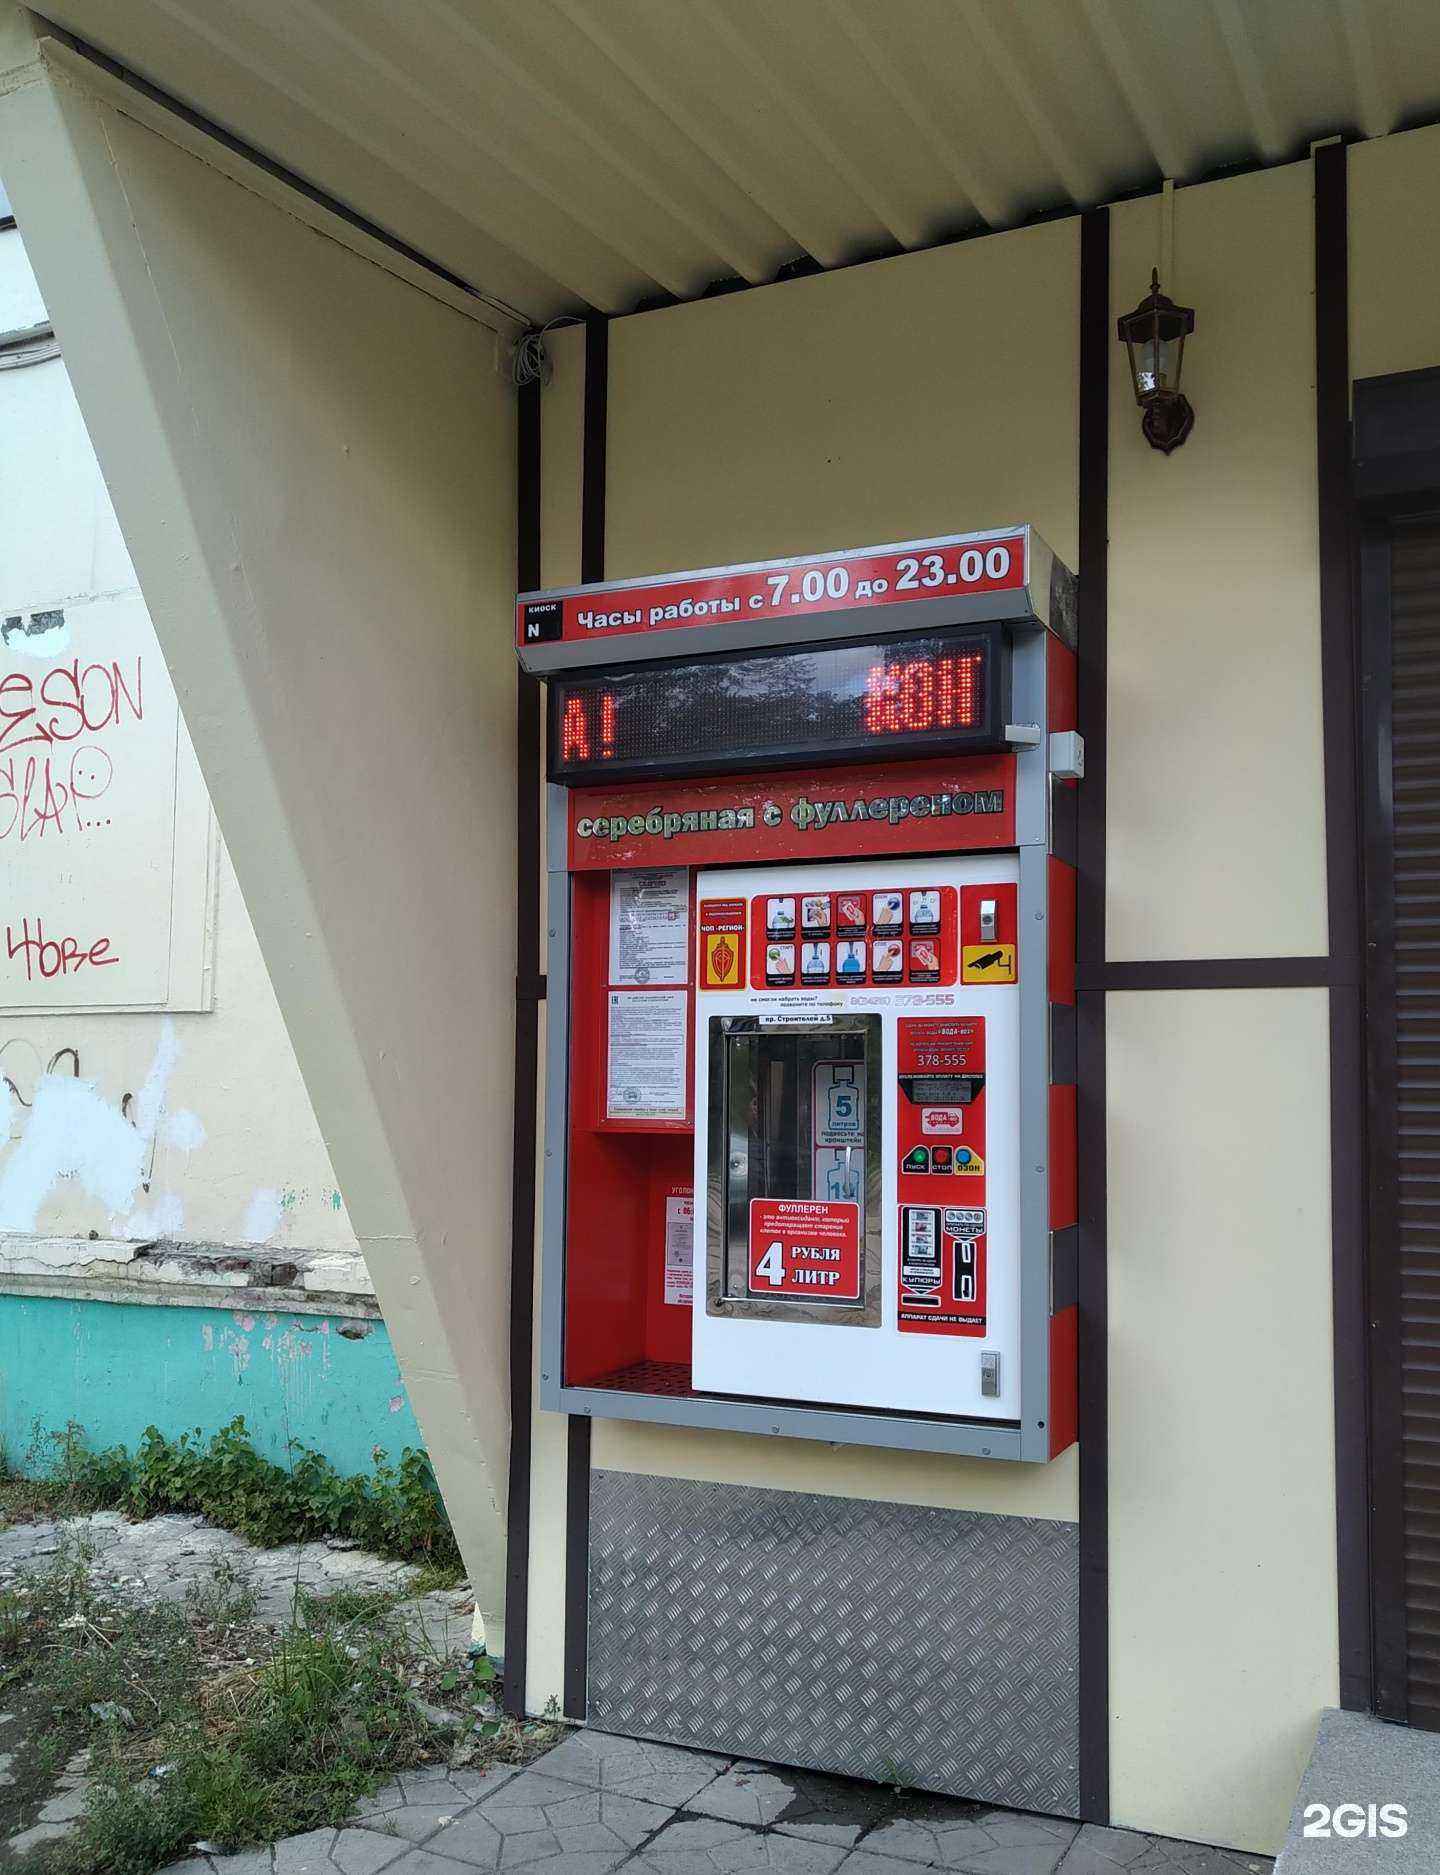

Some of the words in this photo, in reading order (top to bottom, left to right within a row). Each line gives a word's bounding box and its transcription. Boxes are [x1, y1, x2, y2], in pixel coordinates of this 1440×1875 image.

[578, 610, 642, 629] Часы
[649, 597, 740, 626] работы
[748, 594, 764, 609] с
[767, 567, 849, 606] 7.00
[855, 579, 889, 599] до
[895, 546, 1010, 591] 23.00
[577, 807, 755, 841] серебряная
[763, 804, 783, 826] с
[790, 790, 1004, 830] фуллереном
[917, 1054, 967, 1067] 378-555
[835, 1095, 853, 1117] 5
[778, 1204, 829, 1214] ФУЛЛЕРЕН
[791, 1246, 841, 1261] РУБЛЯ
[755, 1241, 786, 1287] 4
[791, 1269, 840, 1286] ЛИТР
